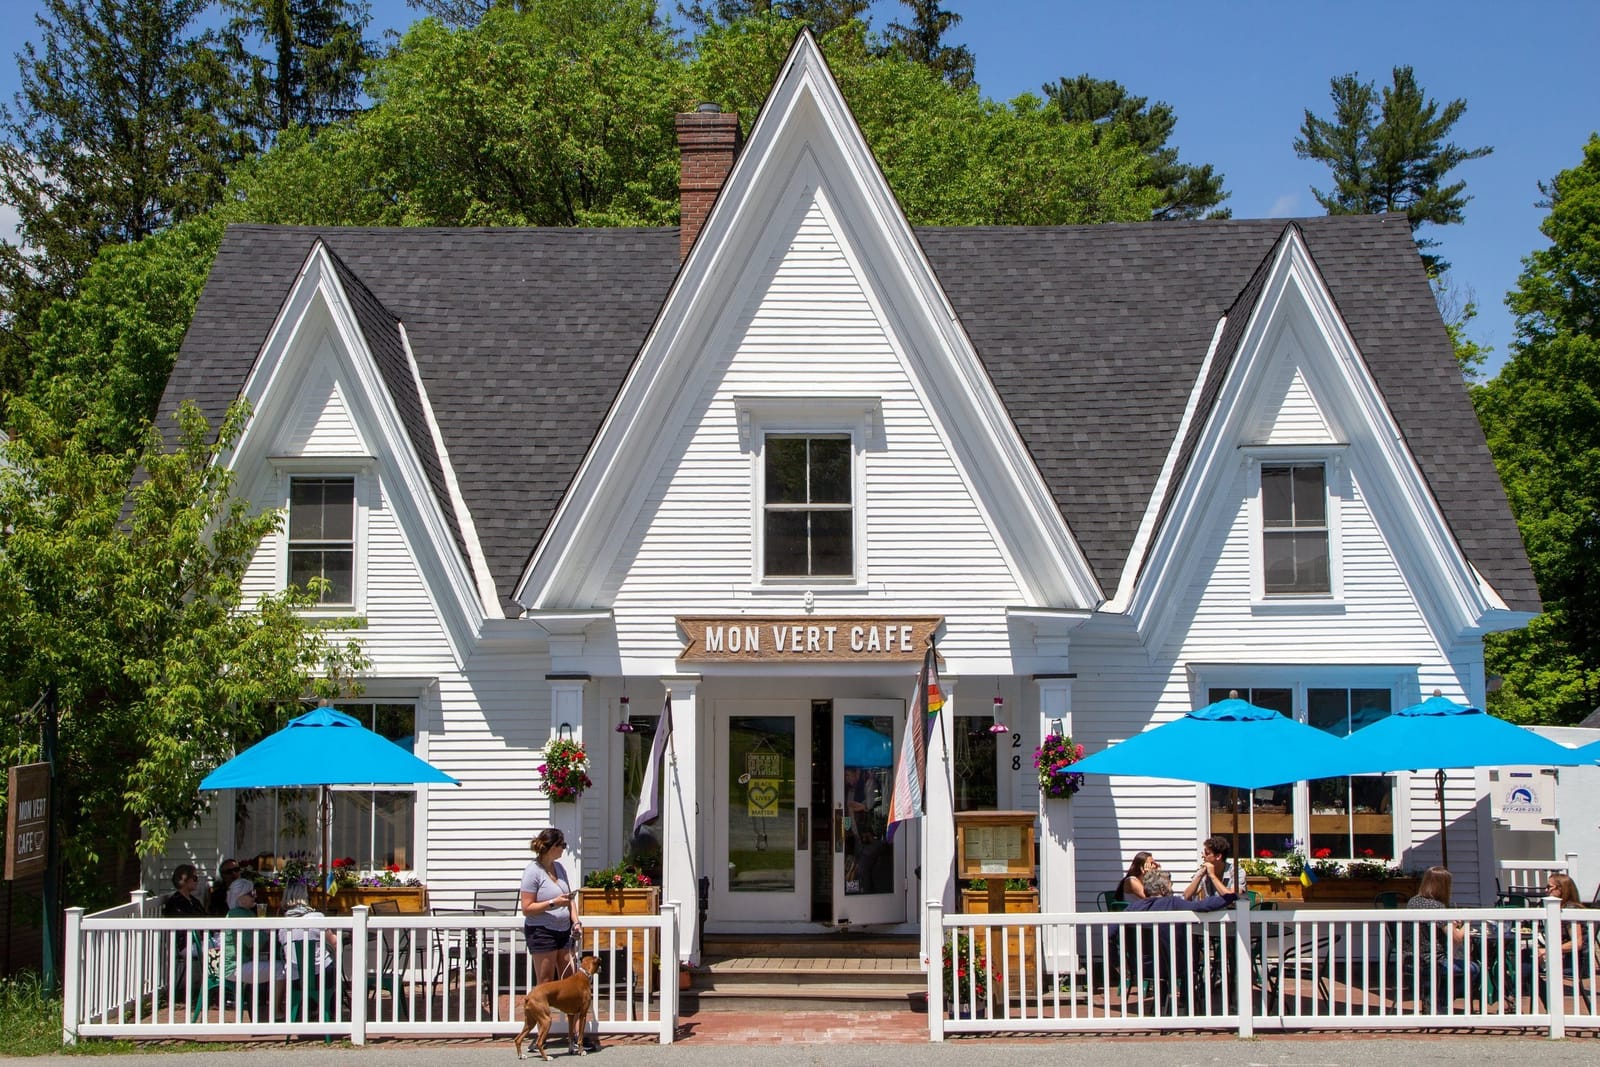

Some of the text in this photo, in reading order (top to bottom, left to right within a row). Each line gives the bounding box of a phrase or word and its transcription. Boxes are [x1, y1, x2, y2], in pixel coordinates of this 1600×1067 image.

[705, 626, 913, 652] MON VERT CAFE
[18, 798, 46, 820] MON VERT
[17, 832, 33, 855] CAFE
